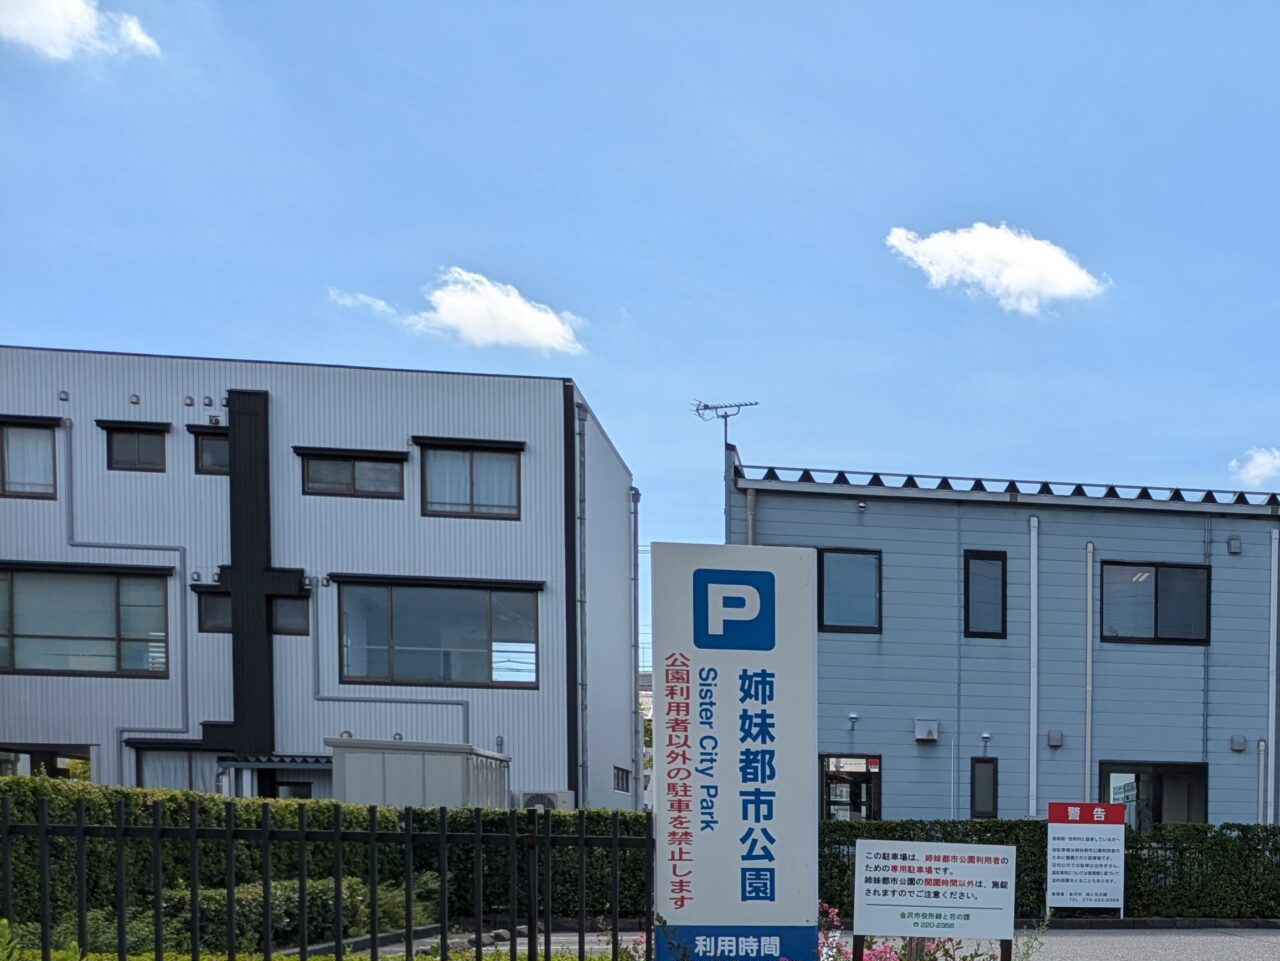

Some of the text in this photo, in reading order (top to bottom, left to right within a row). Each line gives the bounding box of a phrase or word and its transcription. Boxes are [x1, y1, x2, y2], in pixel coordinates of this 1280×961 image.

[707, 583, 761, 635] P
[695, 666, 719, 832] Sister City Park
[664, 652, 694, 910] 公園利用者以外の駐車を禁止します
[738, 668, 776, 902] 姉妹都市公園
[1067, 806, 1106, 821] 警告
[865, 852, 1009, 865] この駐車場は、姉妹都市公園利用者の
[864, 864, 954, 876] ための専用駐車場です。
[864, 889, 979, 901] されますのでご注意ください。
[694, 936, 781, 957] 利用時間
